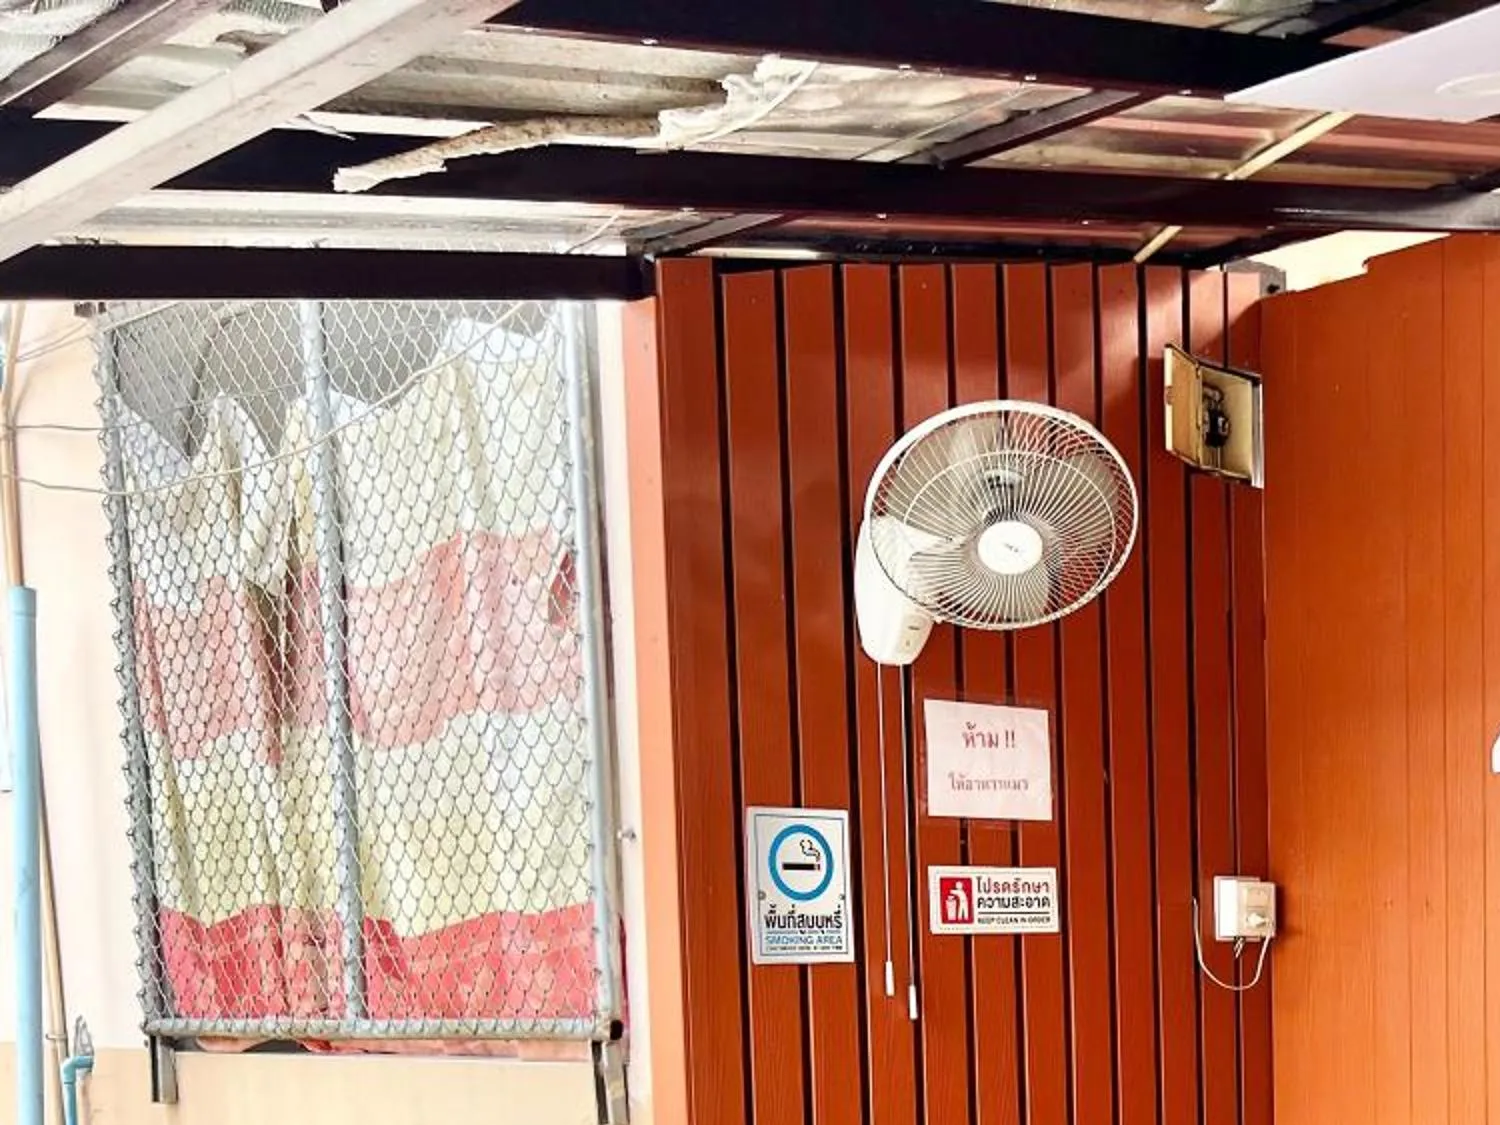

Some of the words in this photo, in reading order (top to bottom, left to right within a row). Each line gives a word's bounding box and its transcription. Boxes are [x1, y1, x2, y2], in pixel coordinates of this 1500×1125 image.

[962, 721, 999, 749] ห้าม
[1004, 730, 1016, 749] !!
[976, 876, 1049, 894] โปรดรักษา
[977, 896, 1050, 909] ความสะอาด
[764, 903, 843, 934] พื้นที่สูบบุหรี่
[765, 935, 814, 944] SMOKING
[816, 935, 843, 944] AREA
